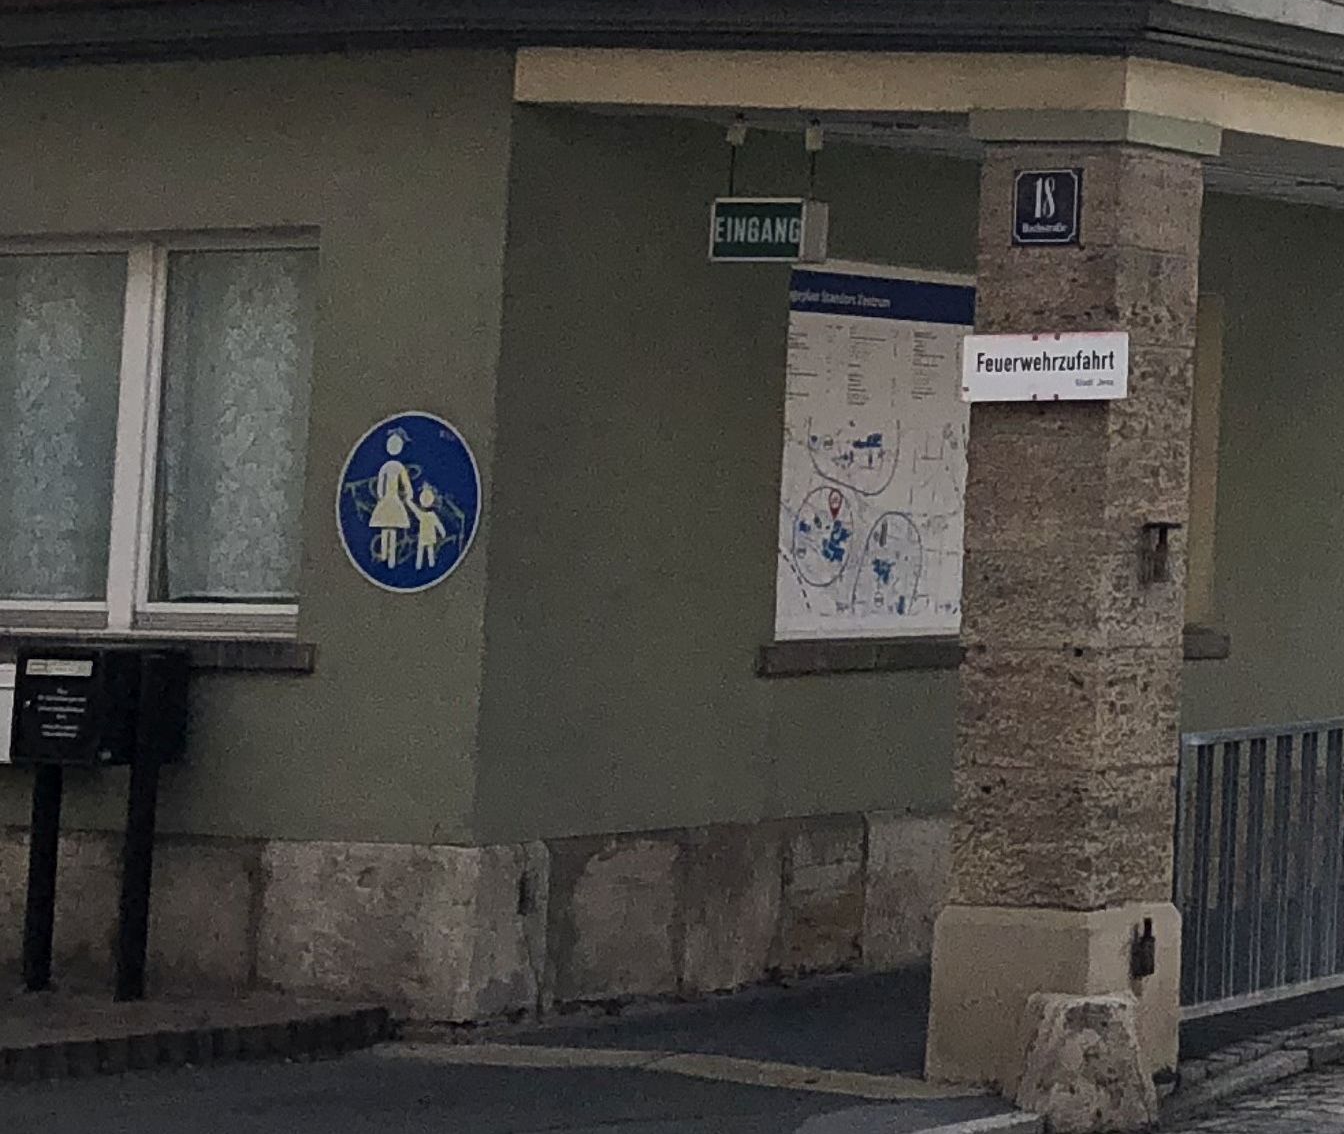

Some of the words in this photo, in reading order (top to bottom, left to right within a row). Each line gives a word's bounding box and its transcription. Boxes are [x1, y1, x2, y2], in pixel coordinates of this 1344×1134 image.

[1034, 176, 1056, 219] 18
[715, 216, 801, 244] EINGANG
[976, 350, 1115, 373] Feuerwehrzufahrt
